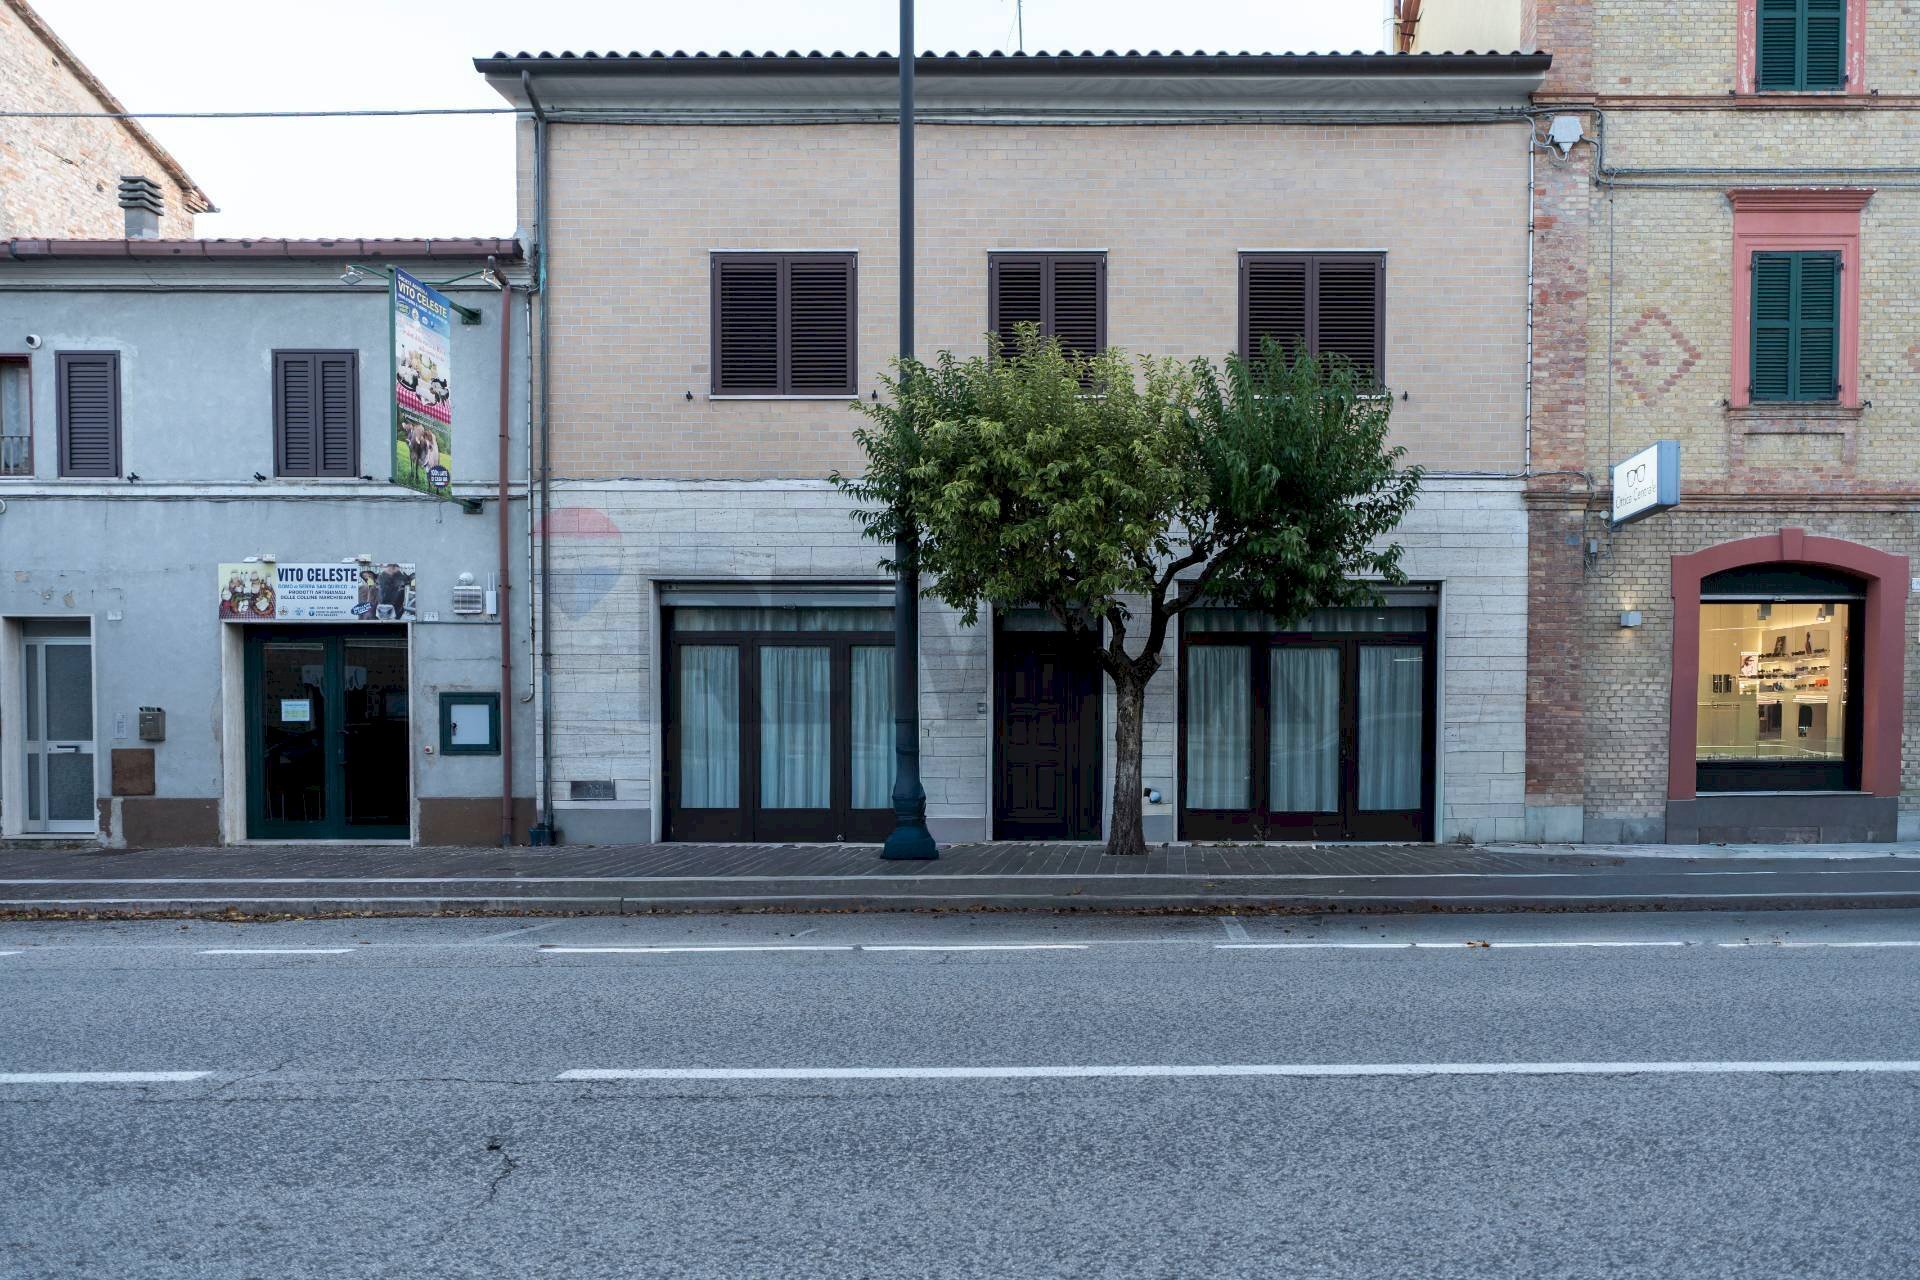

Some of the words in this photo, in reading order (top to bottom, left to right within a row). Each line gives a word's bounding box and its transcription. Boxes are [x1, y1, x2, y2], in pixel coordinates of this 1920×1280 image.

[397, 280, 416, 299] VITO
[416, 292, 448, 319] CELESTE
[277, 567, 304, 582] VITO
[307, 567, 358, 582] CELESTE
